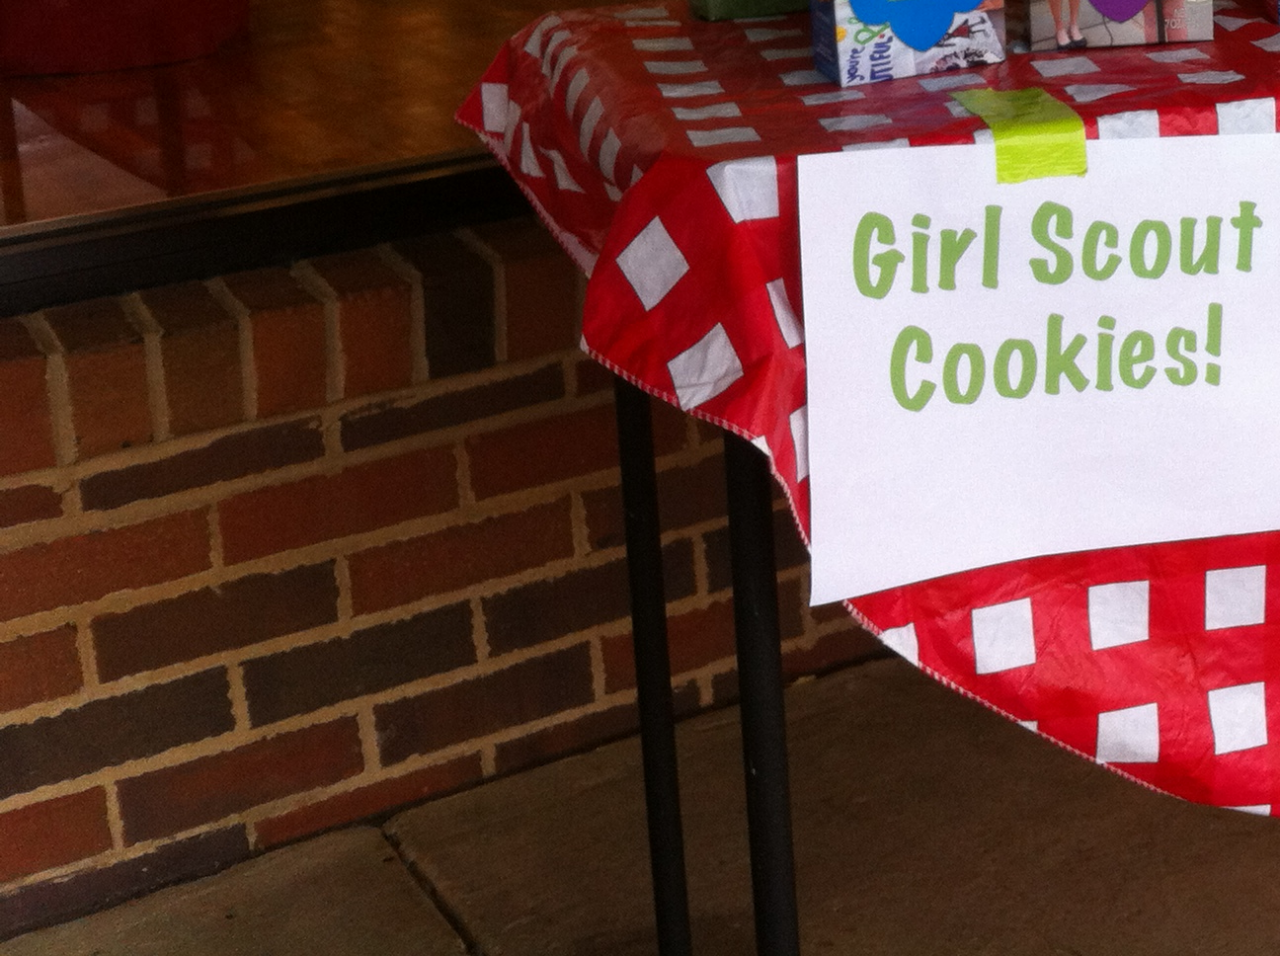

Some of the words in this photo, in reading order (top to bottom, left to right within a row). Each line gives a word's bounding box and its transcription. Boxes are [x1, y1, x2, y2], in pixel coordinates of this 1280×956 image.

[852, 204, 1002, 299] Girl
[1029, 200, 1263, 285] Scout
[890, 302, 1223, 412] Cookies!
